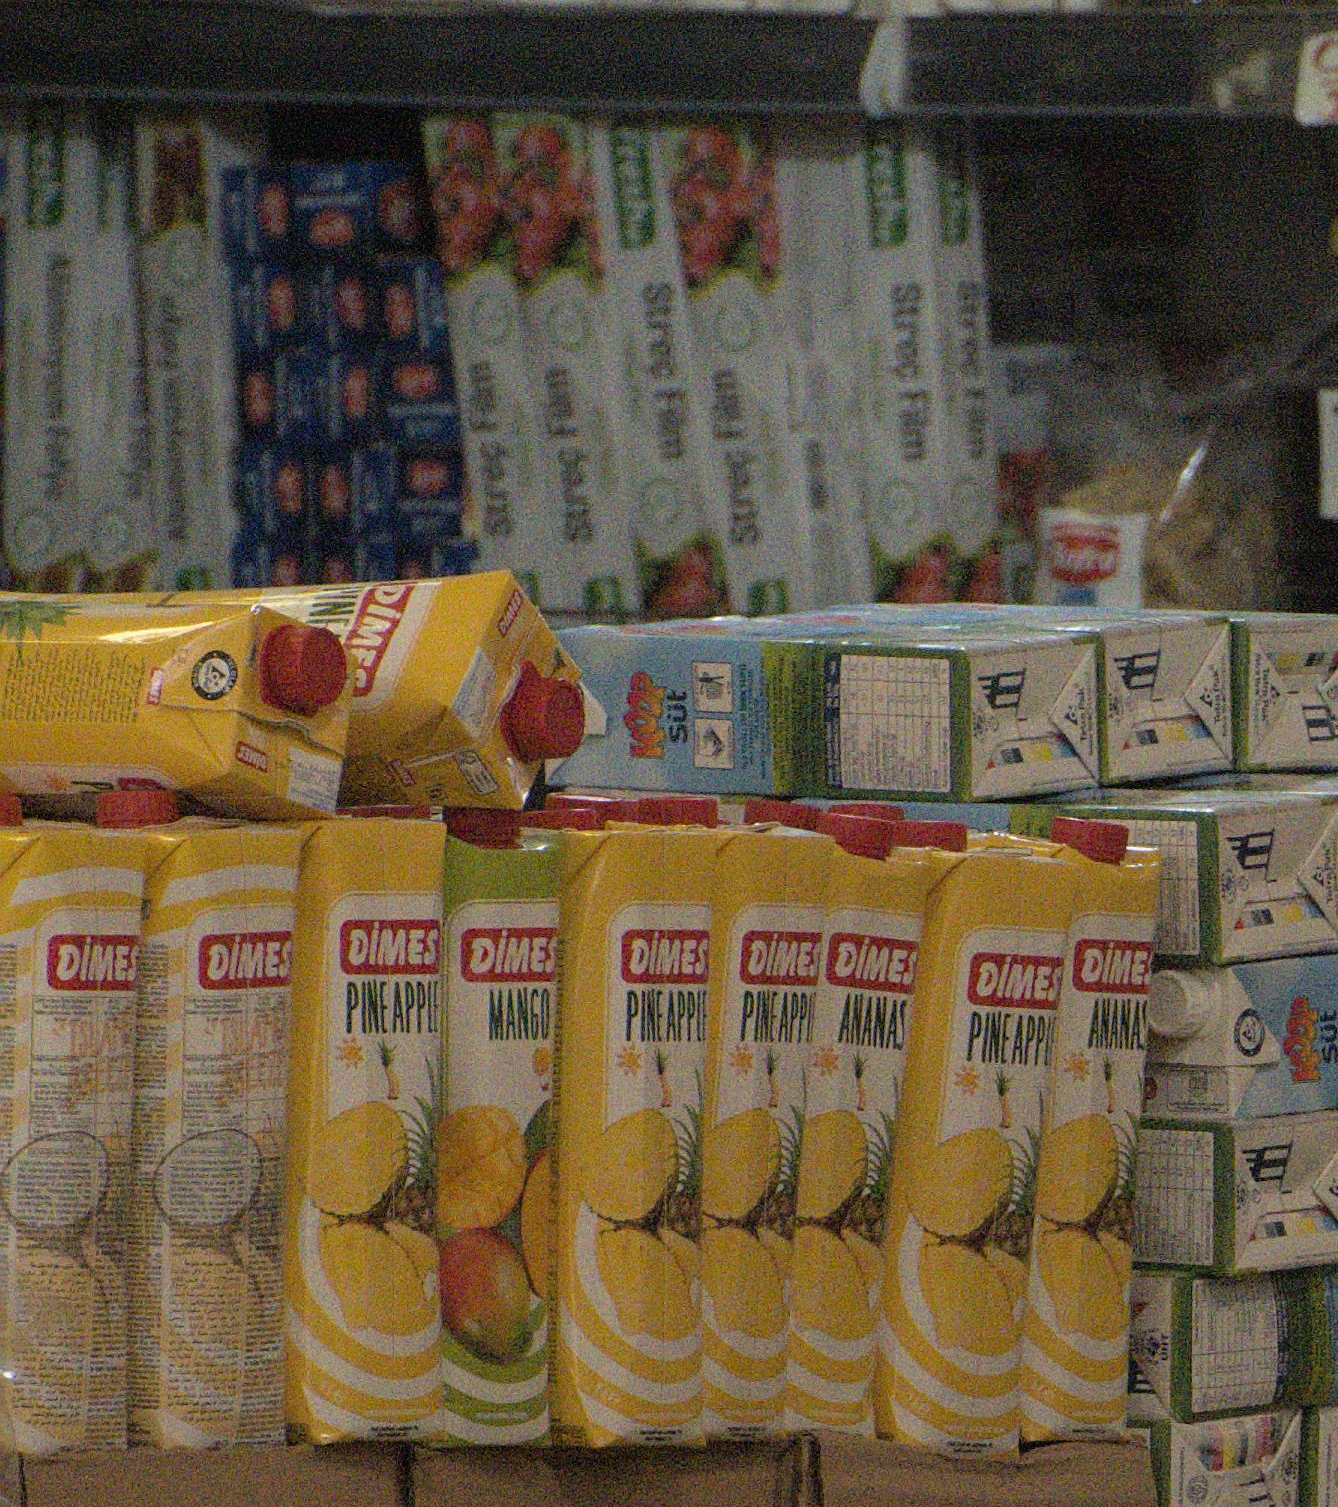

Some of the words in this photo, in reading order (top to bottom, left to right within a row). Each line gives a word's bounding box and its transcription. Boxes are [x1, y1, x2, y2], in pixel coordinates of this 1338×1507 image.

[643, 282, 675, 379] Streç
[891, 282, 923, 380] Streç
[546, 366, 576, 438] Film
[655, 388, 688, 460] Film
[900, 389, 931, 461] Film
